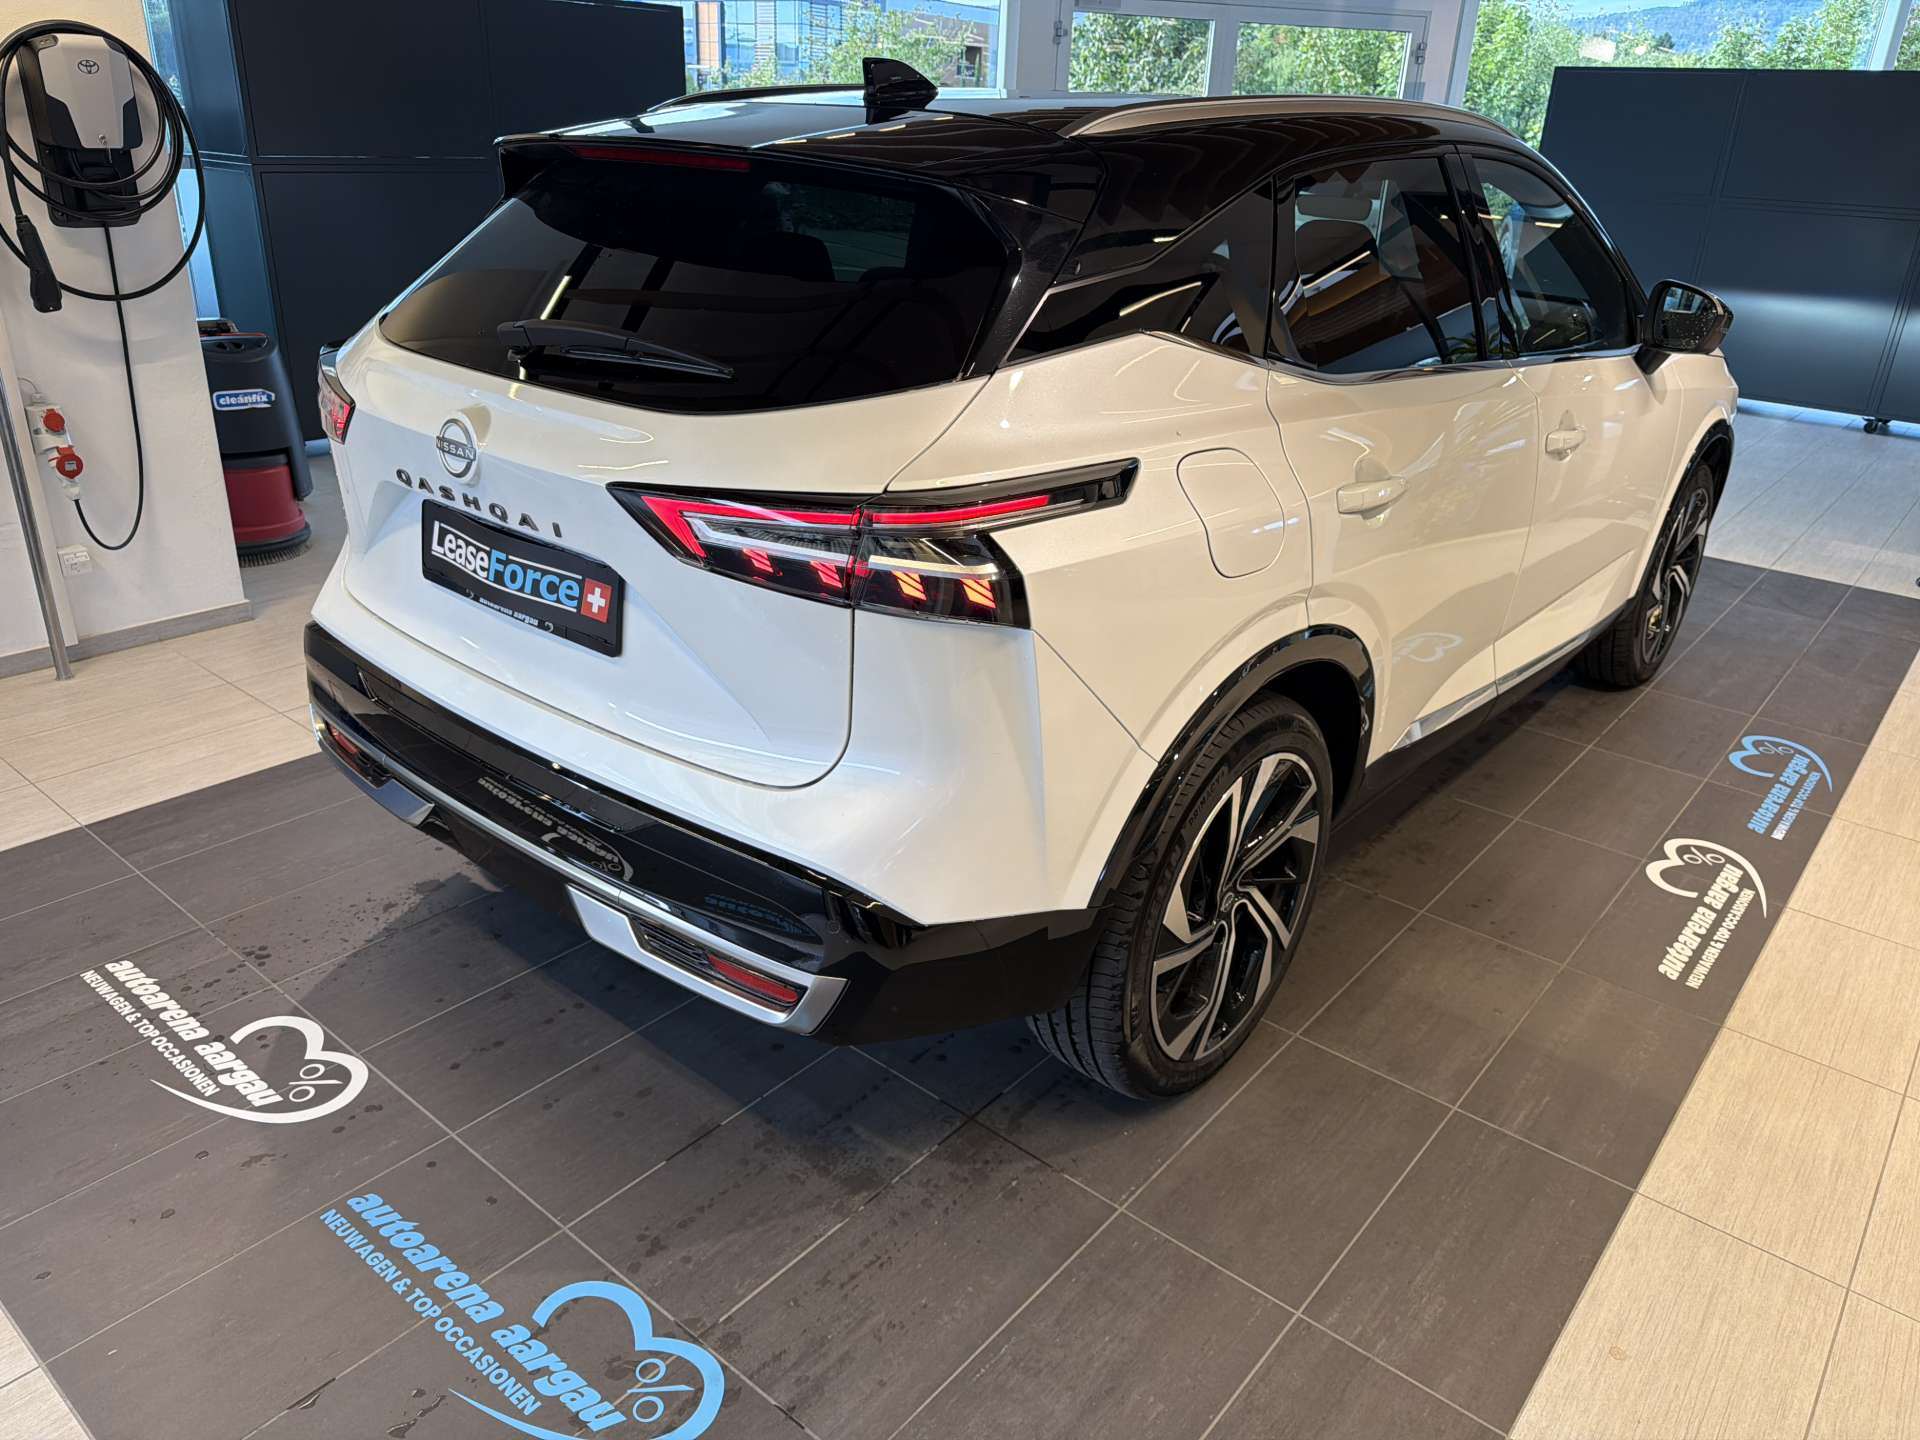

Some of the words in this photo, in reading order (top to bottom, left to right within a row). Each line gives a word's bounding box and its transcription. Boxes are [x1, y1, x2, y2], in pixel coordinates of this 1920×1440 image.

[219, 392, 268, 405] cleanfix
[436, 438, 474, 460] NISSAN
[396, 468, 563, 538] QASHQAI
[431, 521, 580, 607] LeaseForce
[1746, 783, 1791, 834] autoarena
[1779, 753, 1810, 787] aargau
[1658, 906, 1717, 980] autoarena
[1703, 864, 1744, 910] aargau
[1685, 946, 1721, 989] NEUWAGEN
[1712, 928, 1732, 943] TOP
[1722, 888, 1756, 930] OCCASIONEN
[80, 970, 134, 1017] NEUWAGEN
[132, 1018, 159, 1038] TOP
[151, 1035, 222, 1097] OCCASIONEN
[104, 960, 210, 1042] autoarena
[194, 1041, 283, 1107] aargau
[319, 1208, 402, 1282] NEUWAGEN
[392, 1278, 415, 1295] &
[346, 1193, 505, 1323] autoarena
[490, 1324, 627, 1432] aargau
[403, 1287, 441, 1318] TOP
[433, 1315, 541, 1416] OCCASIONEN
